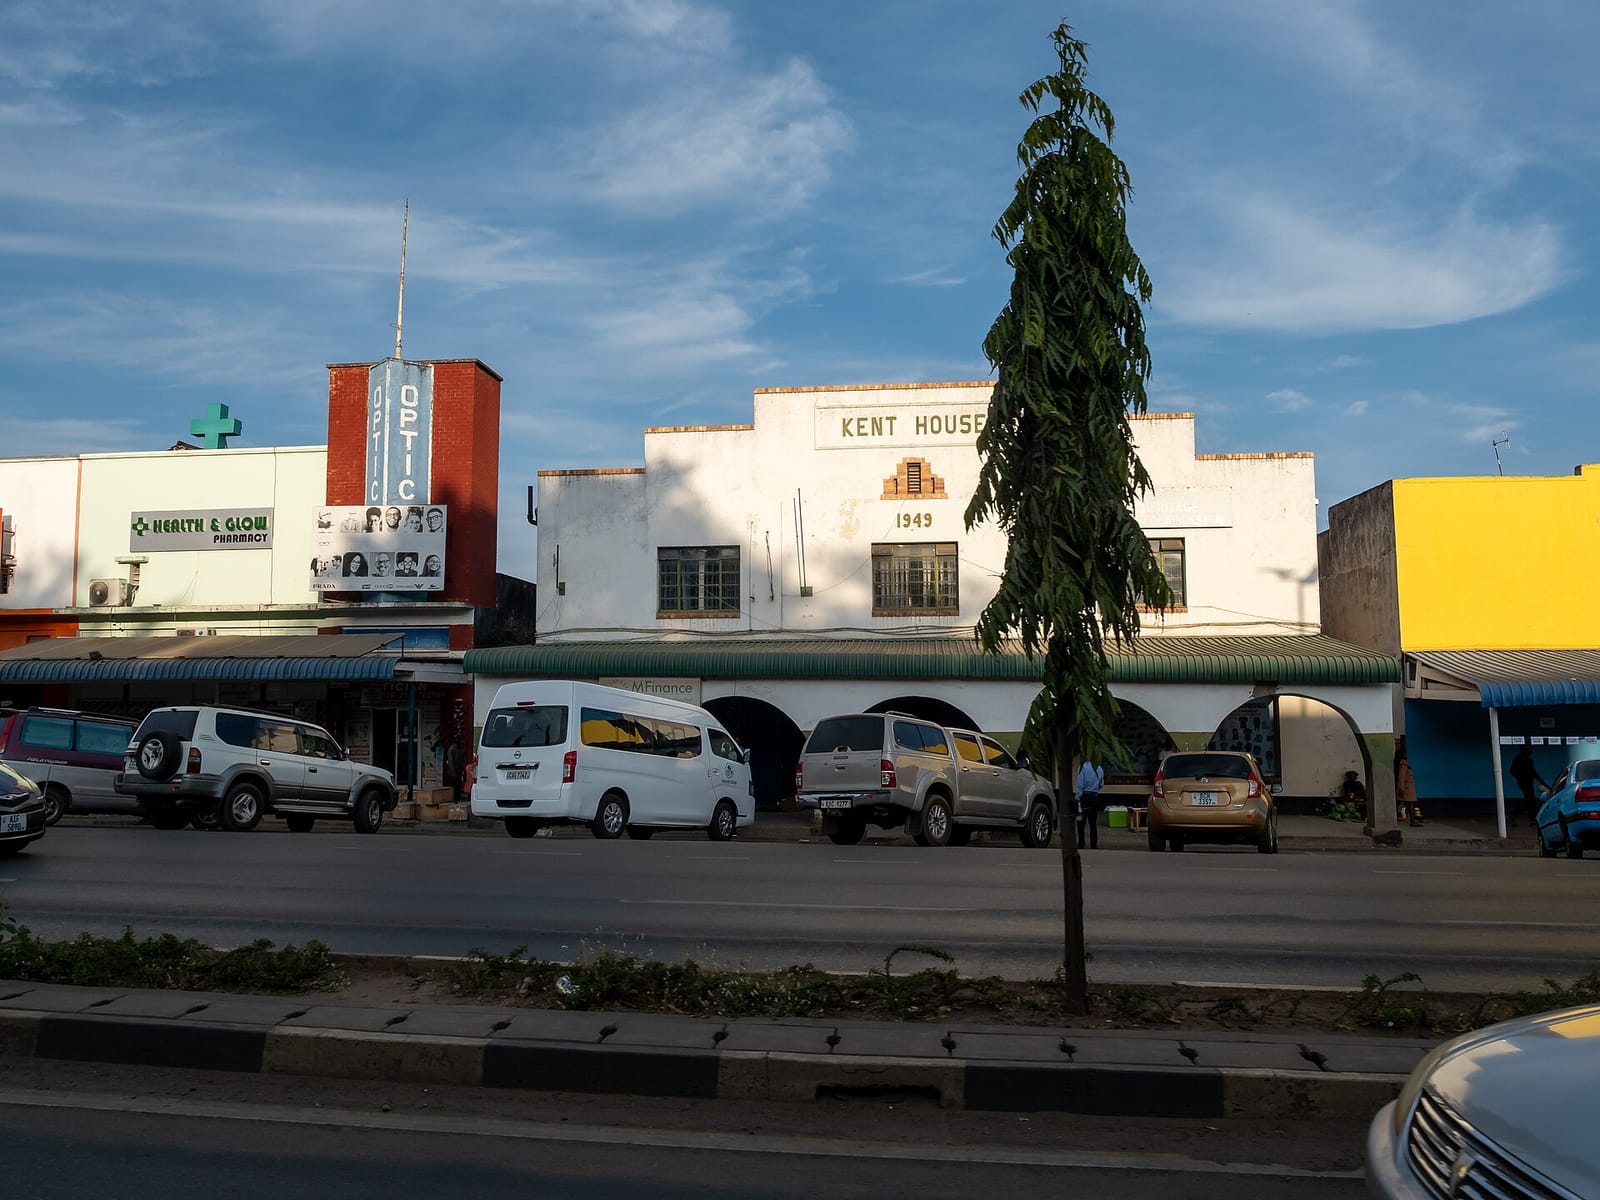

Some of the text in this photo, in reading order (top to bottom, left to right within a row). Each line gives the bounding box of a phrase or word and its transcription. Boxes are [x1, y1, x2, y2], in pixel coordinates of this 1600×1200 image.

[842, 414, 986, 437] KENT HOUSE
[371, 385, 382, 501] OPTIC
[398, 384, 419, 500] OPTIC
[153, 516, 267, 533] HEALTH & GLOW
[896, 513, 933, 528] 1949
[213, 533, 268, 543] PHARMACY
